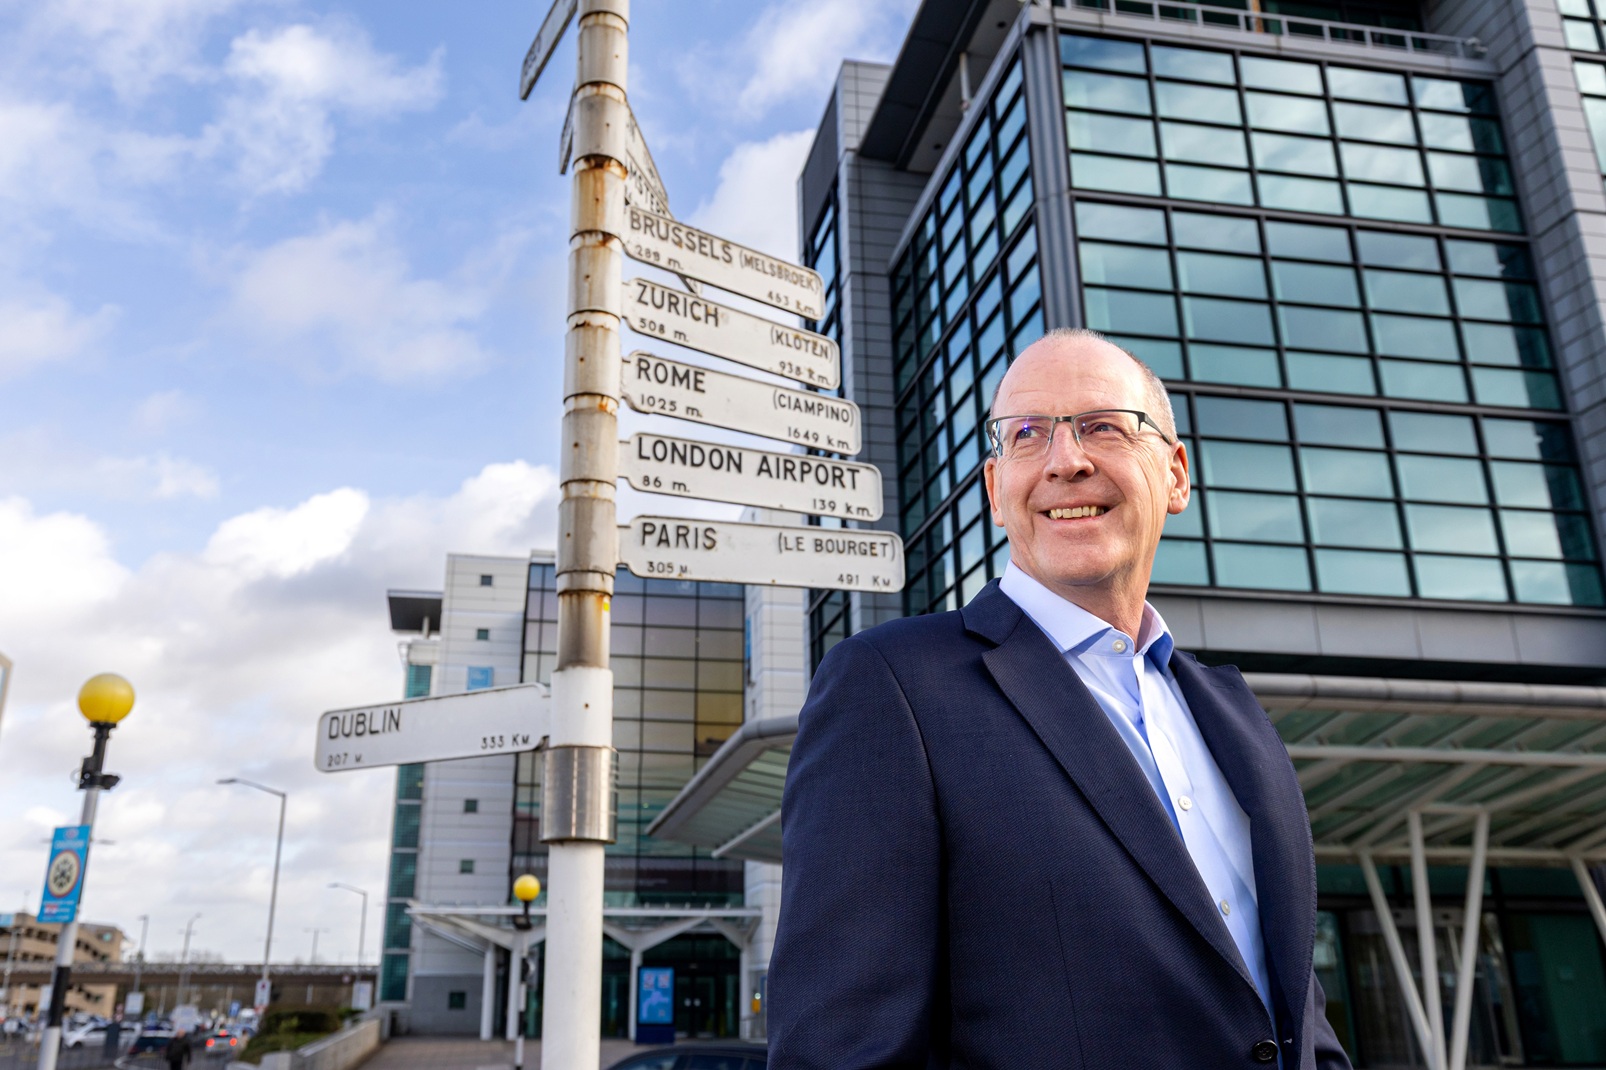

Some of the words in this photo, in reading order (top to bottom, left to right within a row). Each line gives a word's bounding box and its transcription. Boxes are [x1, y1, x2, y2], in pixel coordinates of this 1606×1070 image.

[630, 209, 733, 264] BRUSSELS
[739, 249, 820, 295] (MELSBROEK)
[766, 290, 790, 306] 463
[636, 282, 719, 327] ZURICH
[770, 325, 833, 364] (KLOTEN)
[640, 317, 666, 334] 508
[779, 360, 803, 377] 938
[637, 356, 706, 394] ROME
[773, 389, 855, 428] (CIAMPINO)
[641, 393, 677, 412] 1025
[788, 426, 819, 443] 1649
[638, 436, 742, 474] LONDON
[757, 455, 860, 491] AIRPORT
[642, 475, 662, 489] 86
[672, 480, 691, 493] m.
[813, 498, 837, 512] 139
[641, 522, 718, 550] PARIS
[778, 531, 806, 555] (LE
[813, 538, 896, 562] BOURGET)
[647, 560, 675, 574] 305
[837, 573, 860, 585] 491
[328, 707, 401, 740] DUBLIN
[481, 734, 505, 750] 333
[327, 752, 348, 768] 207
